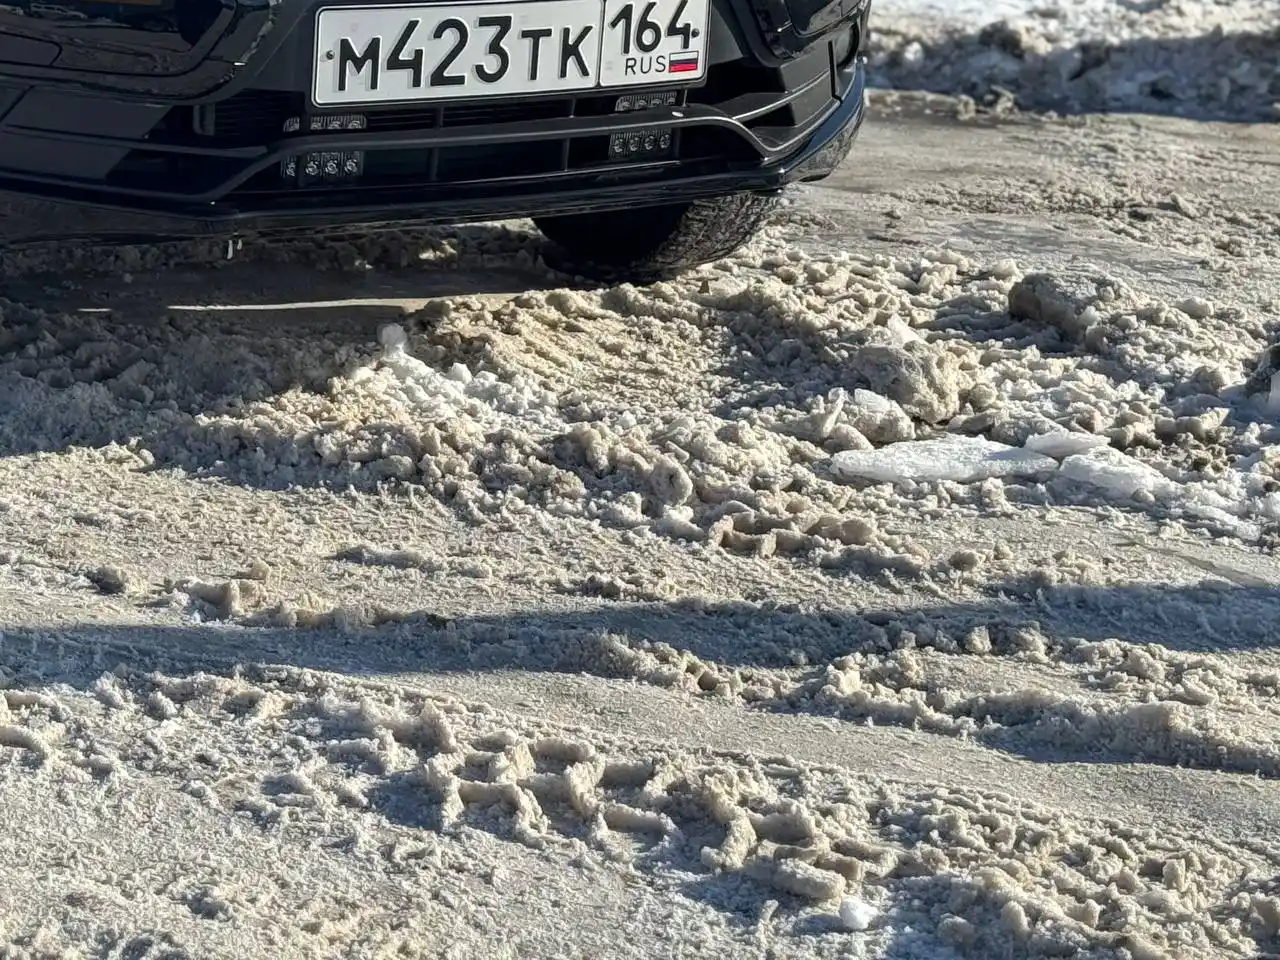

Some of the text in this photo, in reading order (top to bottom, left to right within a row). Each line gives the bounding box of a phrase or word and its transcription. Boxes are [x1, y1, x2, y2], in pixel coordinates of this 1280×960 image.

[338, 0, 692, 92] М423ТК 164
[624, 54, 667, 76] RUS
